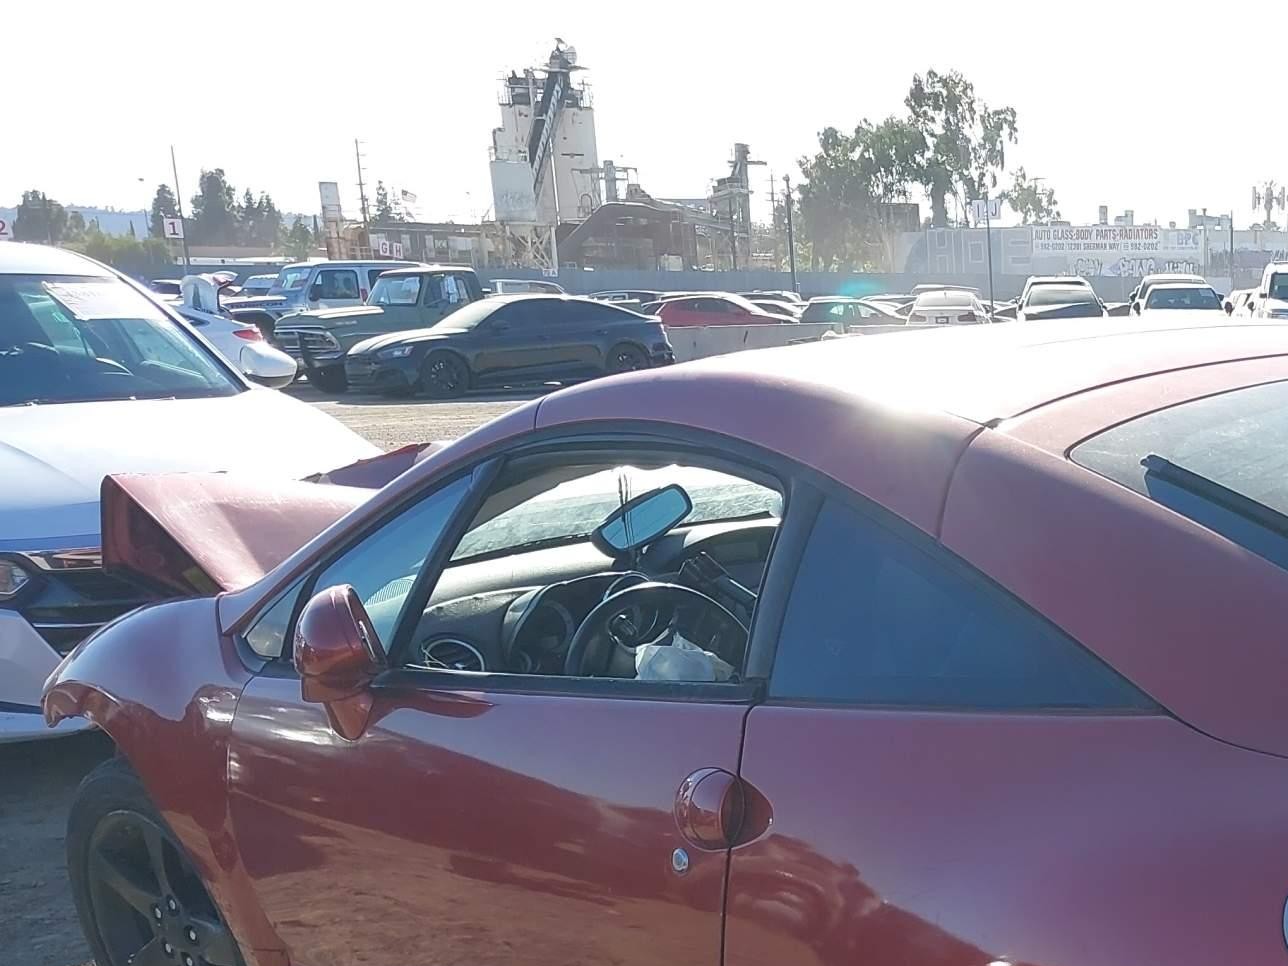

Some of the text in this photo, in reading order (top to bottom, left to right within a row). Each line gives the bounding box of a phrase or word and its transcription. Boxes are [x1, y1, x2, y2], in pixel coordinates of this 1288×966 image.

[991, 202, 997, 217] J
[168, 221, 180, 235] 1
[1034, 229, 1051, 240] AUTO
[381, 242, 388, 254] G
[395, 243, 401, 257] H
[1083, 242, 1107, 250] SHERMAN
[1108, 242, 1120, 250] WAY
